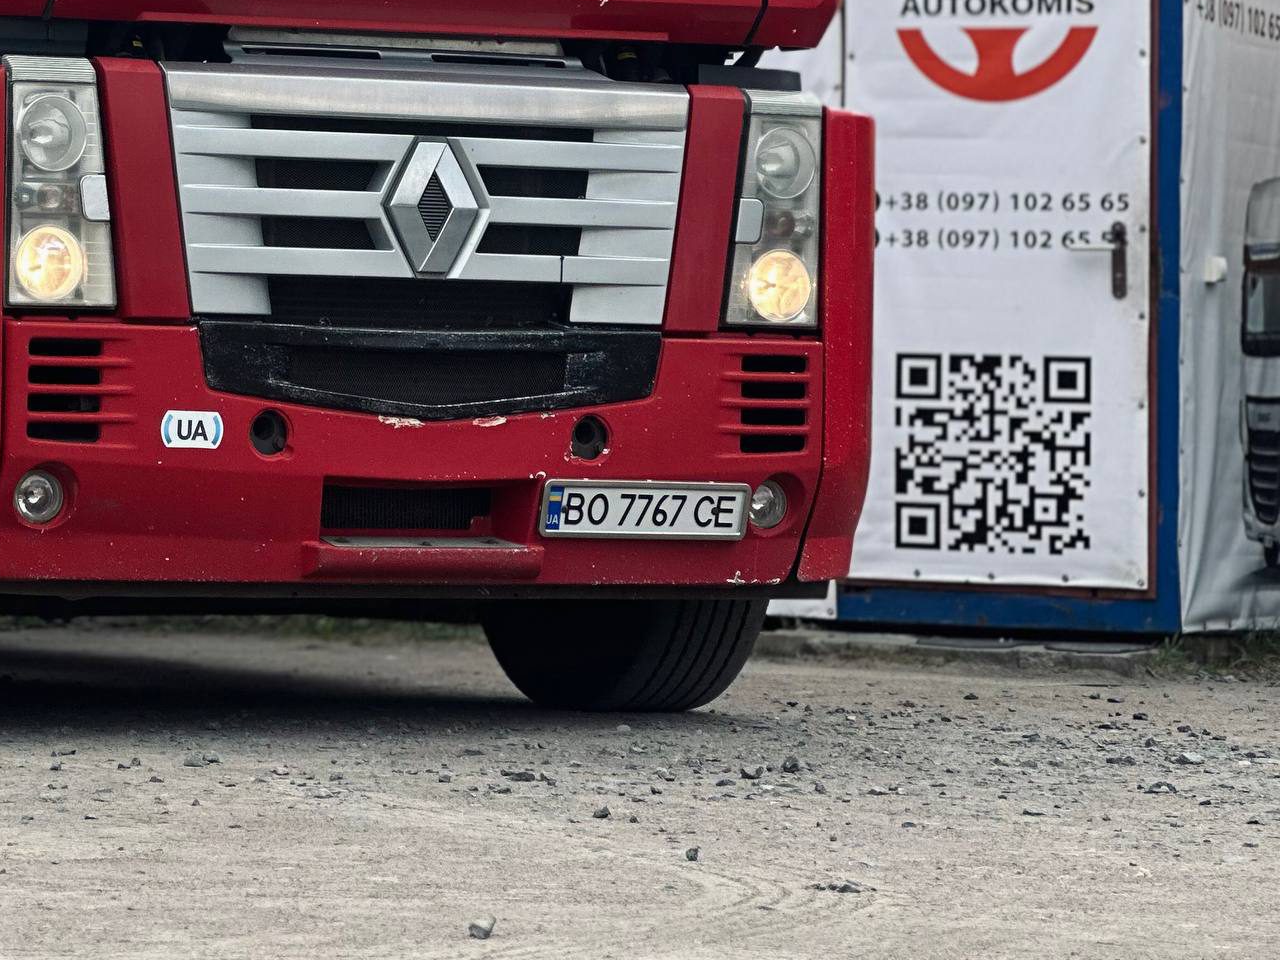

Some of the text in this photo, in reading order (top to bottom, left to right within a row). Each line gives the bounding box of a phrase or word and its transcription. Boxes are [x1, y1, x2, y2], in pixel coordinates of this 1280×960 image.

[1248, 6, 1266, 38] 102
[885, 190, 1130, 215] +38 (097) 102 65 65
[885, 229, 930, 249] +38
[937, 228, 1000, 252] (097)
[1010, 229, 1053, 250] 102
[176, 419, 209, 442] UA
[546, 513, 559, 525] UA
[564, 493, 737, 528] BO 7767 CE
